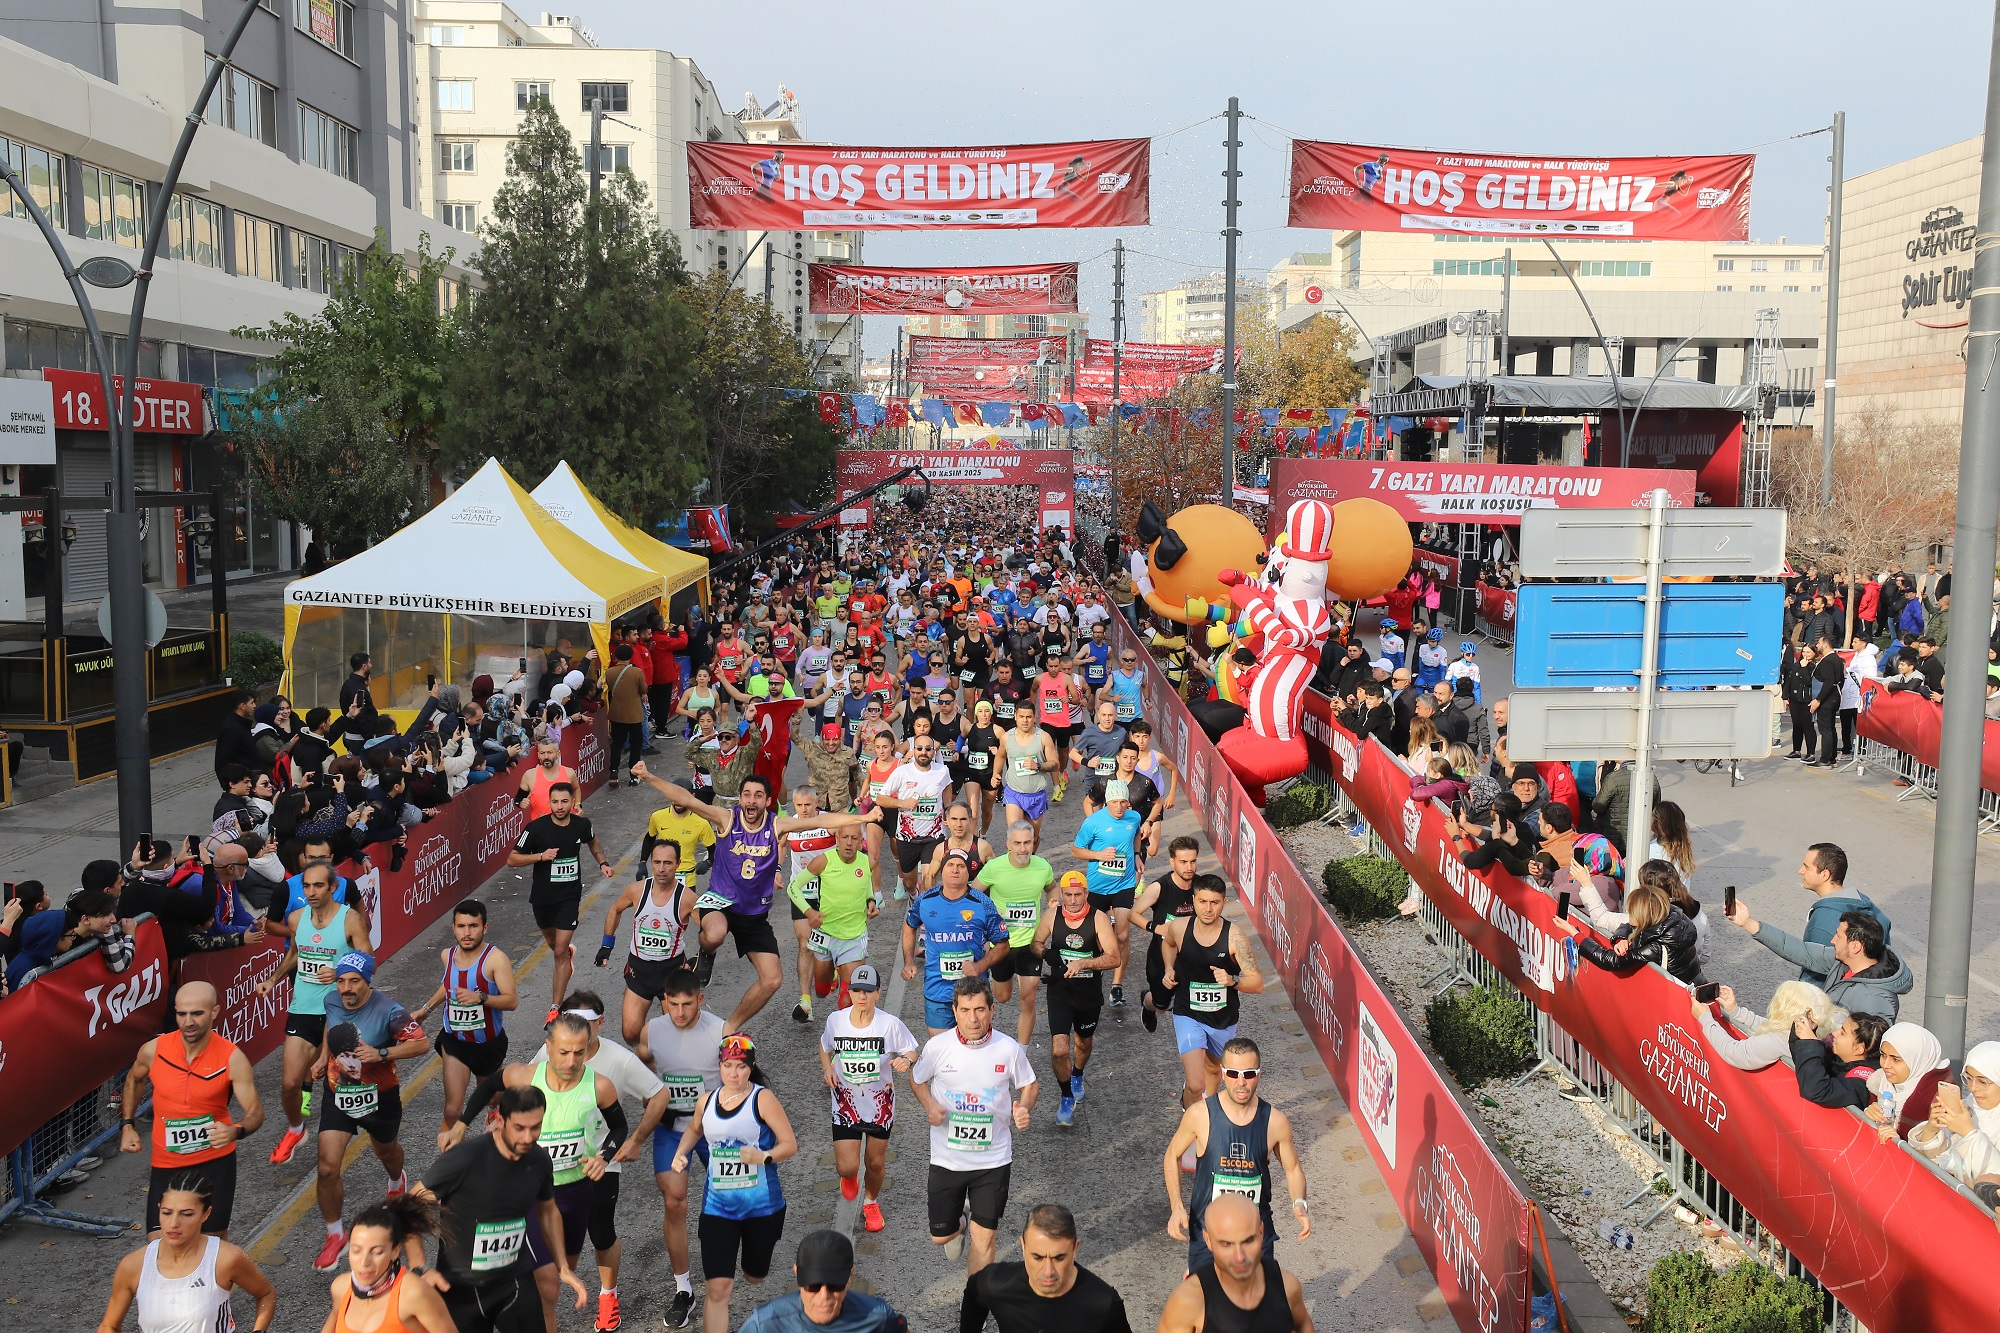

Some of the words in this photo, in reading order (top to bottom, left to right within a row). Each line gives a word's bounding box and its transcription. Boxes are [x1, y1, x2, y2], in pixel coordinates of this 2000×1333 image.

[860, 151, 879, 159] YARI
[880, 150, 926, 159] MARATONU
[940, 149, 961, 159] HALK
[963, 147, 1007, 159] YÜRÜYÜŞÜ
[1464, 157, 1482, 168] YARI
[1484, 158, 1530, 170] MARATONU
[1543, 160, 1564, 170] HALK
[1567, 160, 1610, 173] YÜRÜYÜŞÜ
[783, 163, 865, 207] HOŞ
[1384, 168, 1466, 213] HOŞ
[1901, 269, 1942, 319] Şehir
[61, 390, 99, 425] 18.
[10, 410, 46, 423] ŞEHİTKAMİL
[20, 424, 46, 435] MERKEZİ
[928, 456, 955, 468] YARI
[957, 455, 1021, 468] MARATONU
[927, 470, 938, 478] 30
[939, 469, 962, 477] KASIM
[963, 469, 982, 477] 2025
[1440, 473, 1483, 493] YARI
[1489, 475, 1603, 497] MARATONU
[1440, 498, 1475, 510] HALK
[1480, 498, 1533, 513] KOŞUSU
[292, 589, 384, 606] GAZİANTEP
[388, 594, 495, 613] BÜYÜKŞEHİR
[499, 600, 593, 620] BELEDİYESİ
[74, 660, 100, 673] TAVUK
[486, 798, 516, 830] BÜYÜKŞEHİR
[729, 839, 772, 858] LAKERS
[414, 840, 451, 877] BÜYÜKŞEHİR
[556, 865, 575, 874] 1115
[741, 859, 756, 880] 6
[1008, 909, 1034, 919] 1097
[1467, 871, 1492, 921] YARI
[1489, 894, 1566, 982] MARATONU
[640, 936, 668, 948] 1590
[1195, 991, 1222, 1002] 1315
[453, 1009, 479, 1021] 1773
[1657, 1024, 1711, 1083] BÜYÜKŞEHİR
[844, 1061, 876, 1074] 1360
[668, 1086, 699, 1098] 1155
[338, 1092, 374, 1109] 1990
[955, 1100, 986, 1112] Stars
[171, 1127, 209, 1144] 1914
[954, 1126, 987, 1140] 1524
[719, 1162, 750, 1176] 1271
[1220, 1156, 1255, 1169] Escape
[1431, 1145, 1482, 1256] BÜYÜKŞEHİR
[481, 1233, 520, 1254] 1447
